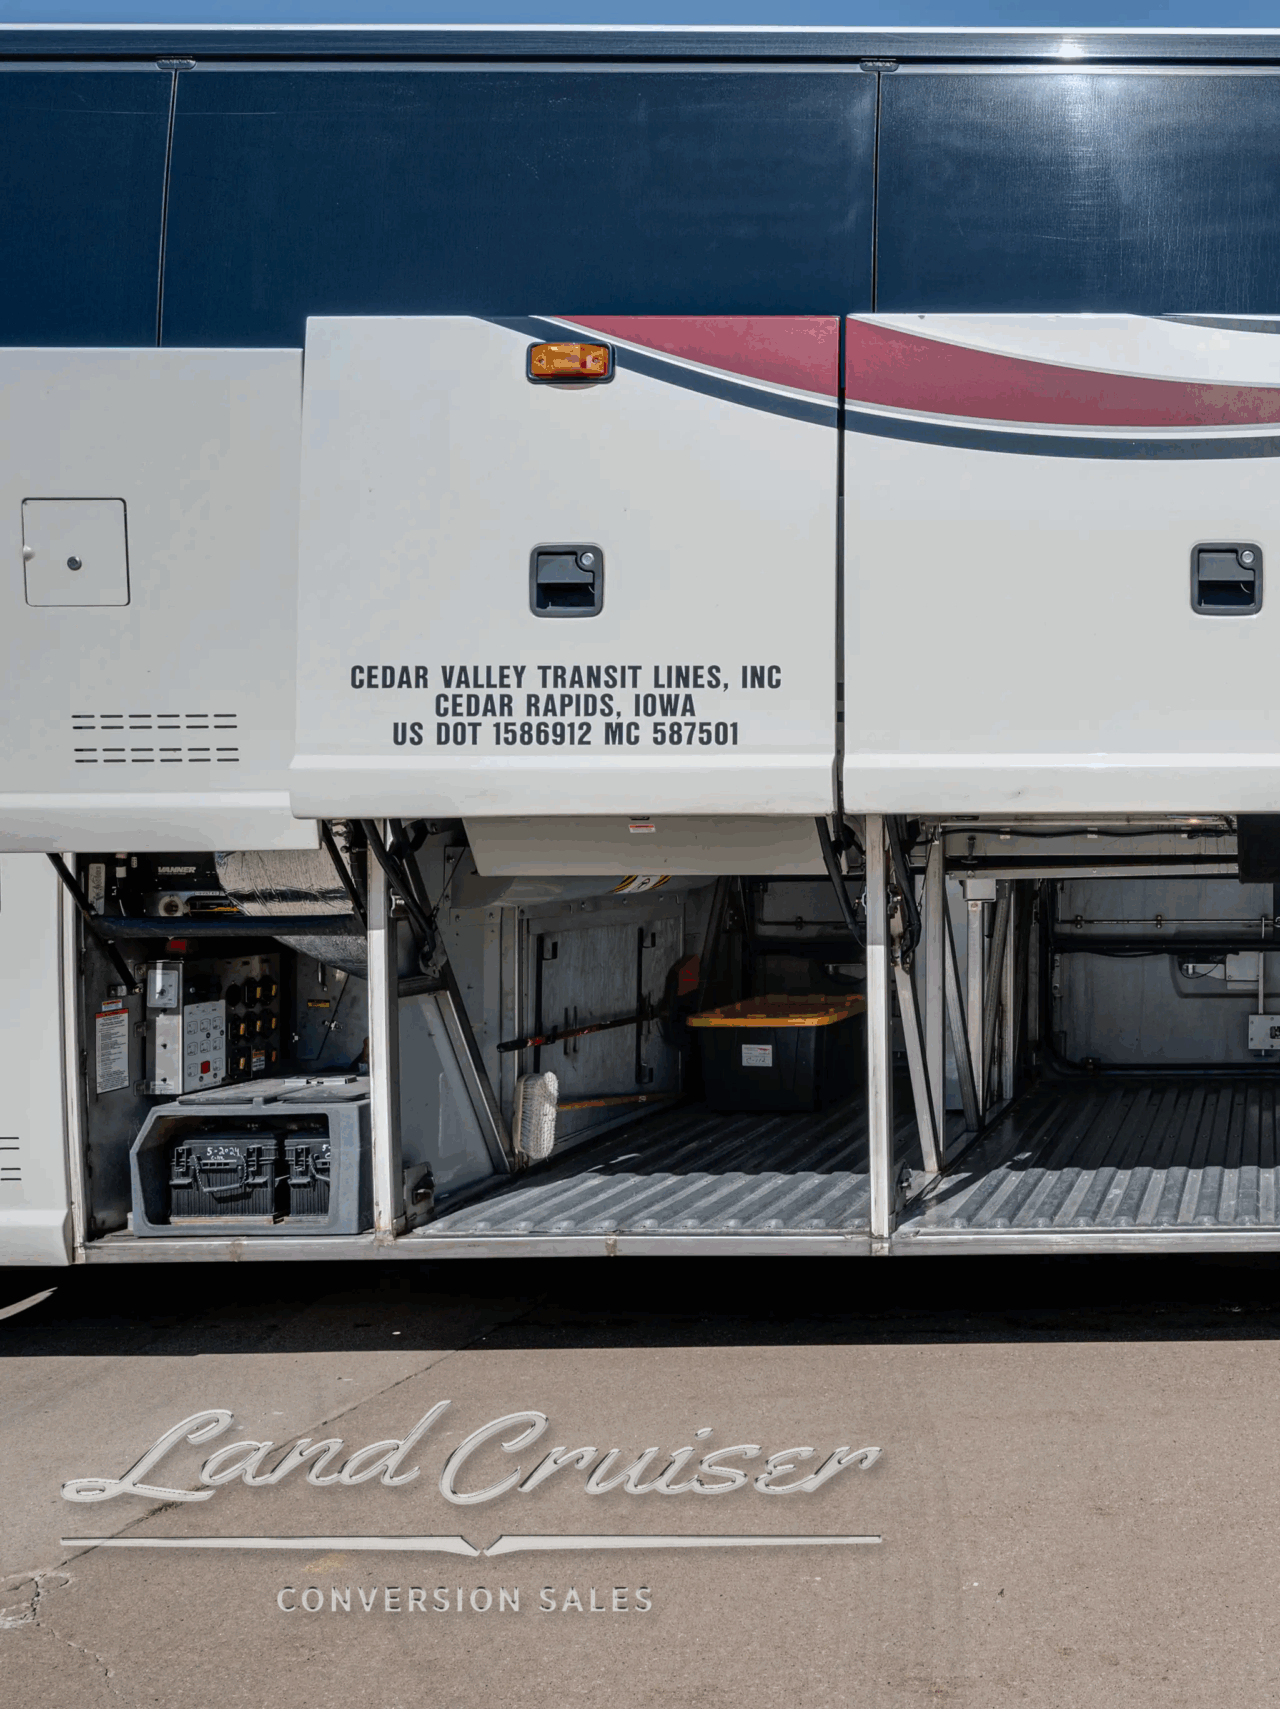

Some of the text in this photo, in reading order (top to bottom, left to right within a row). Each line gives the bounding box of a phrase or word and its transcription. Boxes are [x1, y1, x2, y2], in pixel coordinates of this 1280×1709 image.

[350, 665, 782, 692] CEDAR VALLEY TRANSIT LINES, INC
[435, 693, 696, 720] CEDAR RAPIDS, IOWA
[393, 721, 738, 746] US DOT 1586912 MC 587501
[157, 866, 197, 874] VANNER
